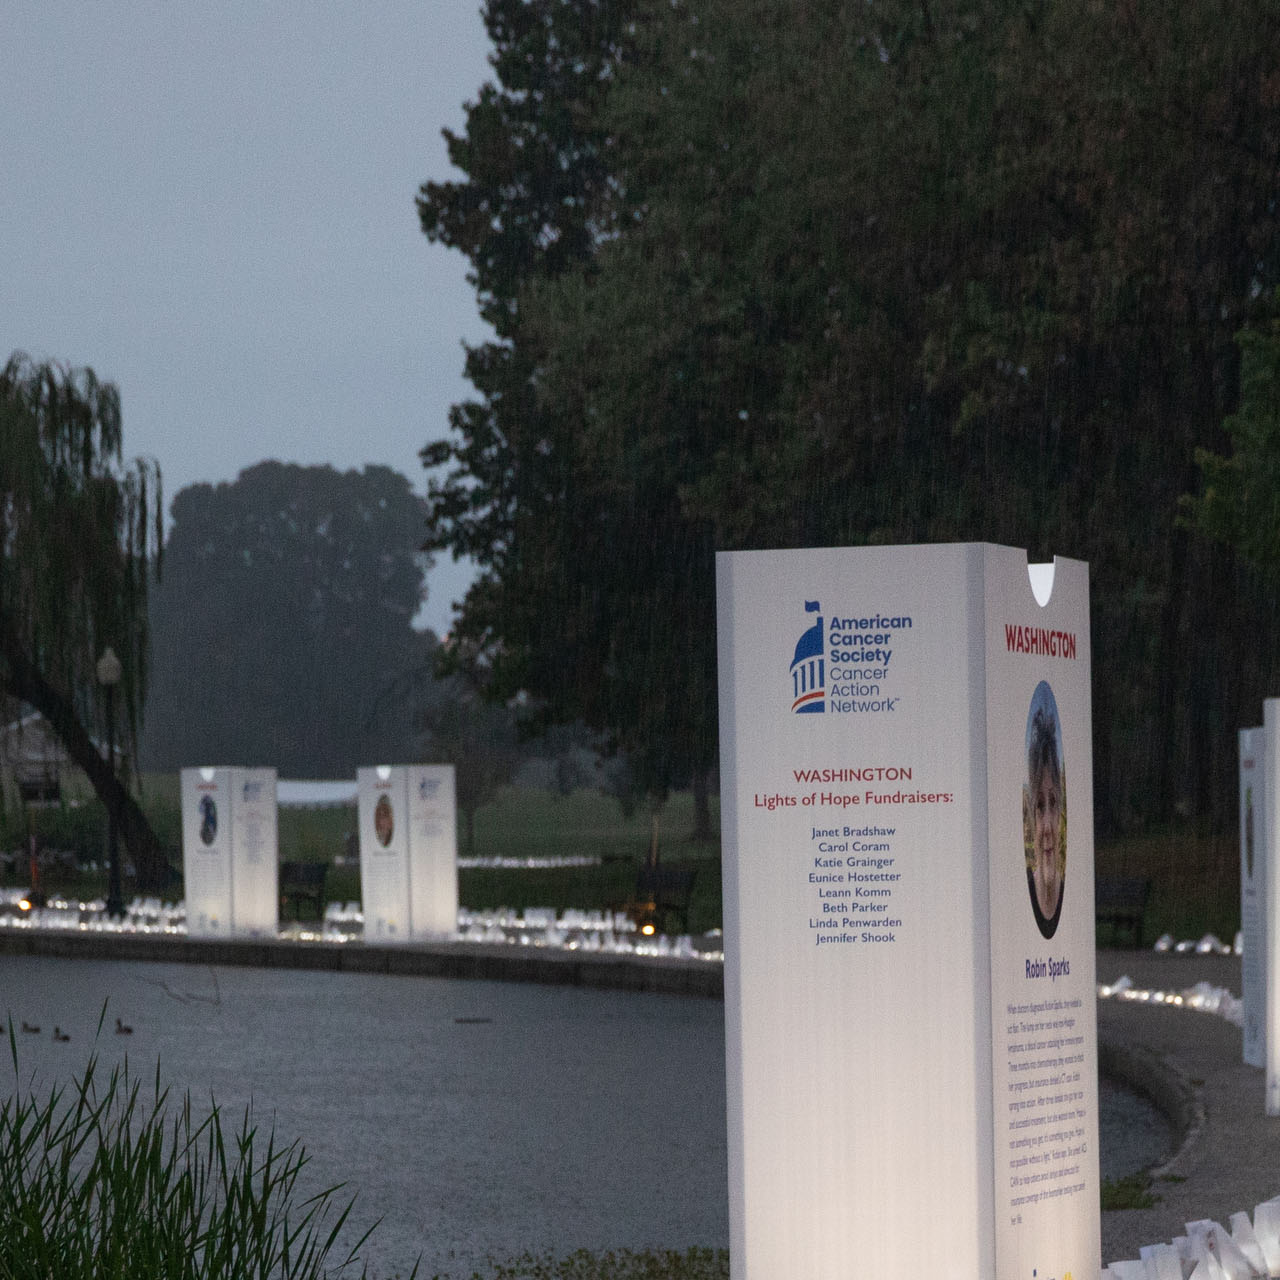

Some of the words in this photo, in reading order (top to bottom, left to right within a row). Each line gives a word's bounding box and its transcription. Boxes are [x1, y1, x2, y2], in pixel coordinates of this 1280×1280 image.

[830, 614, 912, 630] American
[830, 633, 891, 646] Cancer
[1005, 624, 1076, 660] WASHINGTON
[831, 648, 892, 666] Society
[830, 668, 888, 680] Cancer
[831, 683, 879, 696] Action
[793, 768, 912, 783] WASHINGTON
[755, 793, 797, 811] Lights
[802, 792, 816, 806] of
[821, 792, 860, 808] Hope
[865, 790, 953, 804] Fundraisers:
[812, 827, 839, 840] Janet
[843, 826, 896, 837] Bradshaw
[819, 842, 848, 852] Carol
[852, 842, 890, 851] Coram
[815, 857, 843, 868] Katie
[847, 857, 895, 869] Grainger
[809, 873, 844, 883] Eunice
[848, 872, 901, 882] Hostetter
[819, 888, 851, 898] Leann
[855, 887, 891, 897] Komm
[823, 902, 848, 913] Beth
[852, 902, 888, 912] Parker
[809, 918, 838, 928] Linda
[843, 917, 902, 928] Penwarden
[816, 933, 857, 946] Jennifer
[861, 932, 895, 942] Shook
[1026, 958, 1047, 979] Robin
[1048, 957, 1070, 982] Sparks
